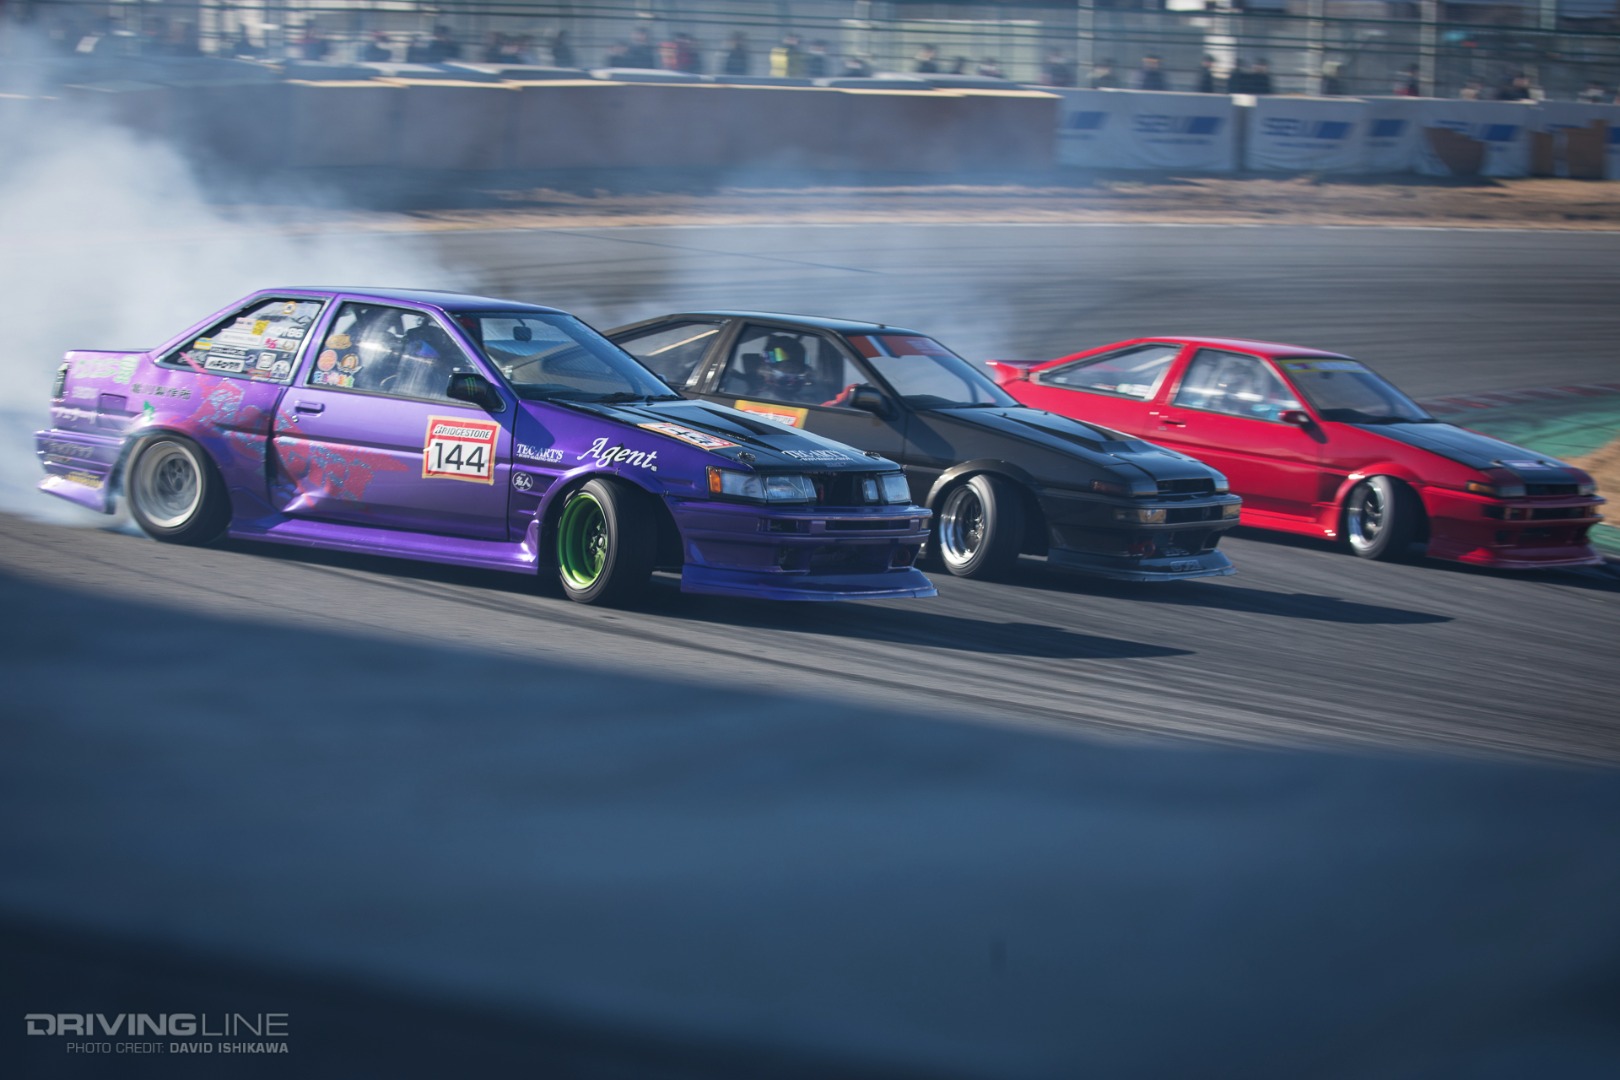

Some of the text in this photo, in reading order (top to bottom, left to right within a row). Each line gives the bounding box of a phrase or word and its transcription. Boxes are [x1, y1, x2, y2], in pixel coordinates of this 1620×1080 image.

[434, 425, 490, 439] BRIDGESTONE
[435, 442, 485, 473] 144
[576, 437, 658, 472] Agent.
